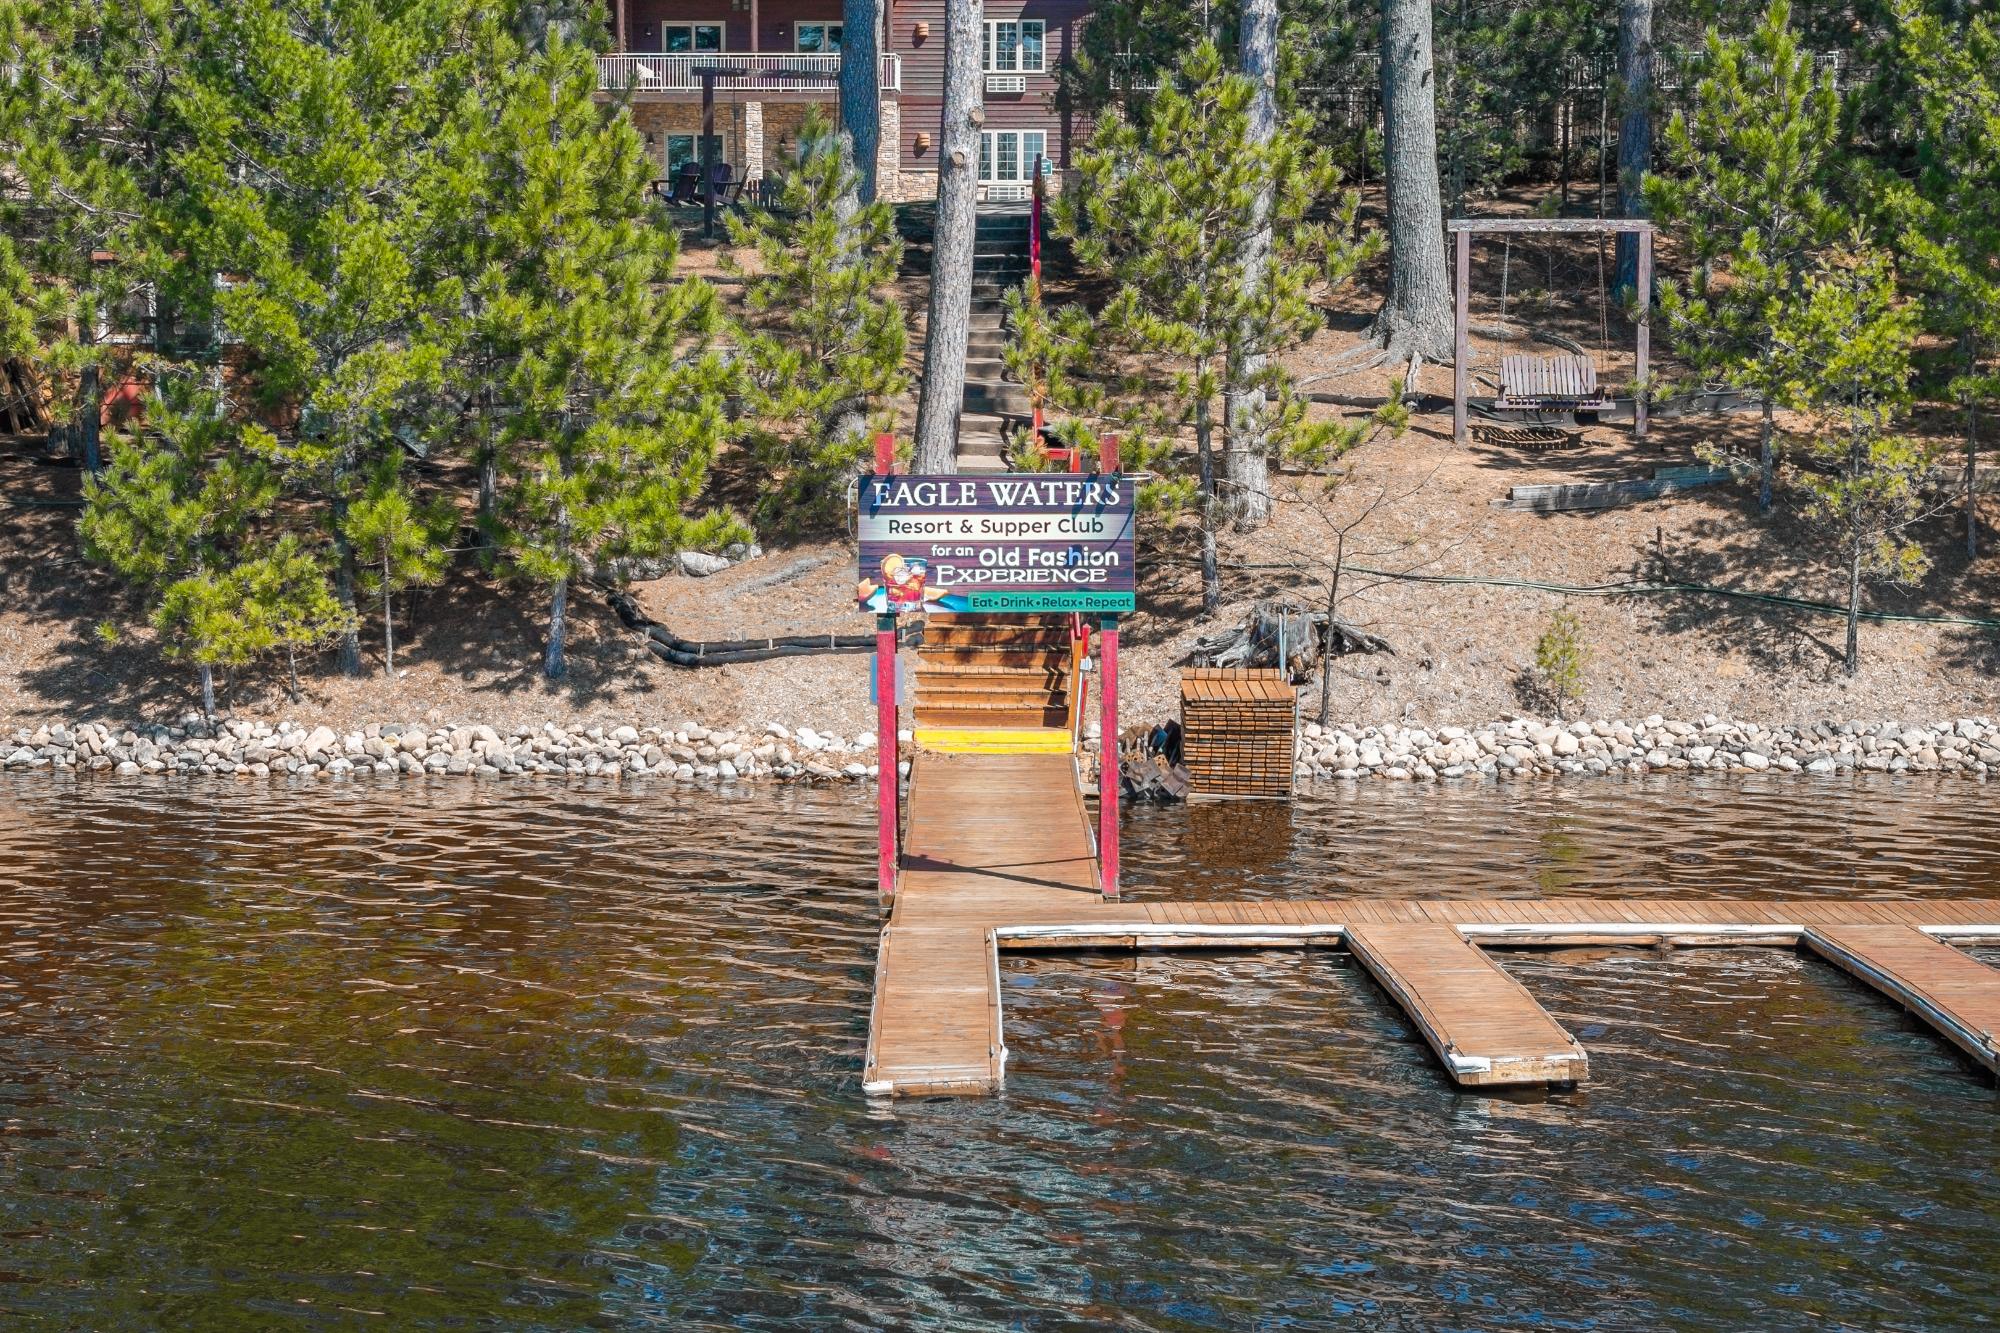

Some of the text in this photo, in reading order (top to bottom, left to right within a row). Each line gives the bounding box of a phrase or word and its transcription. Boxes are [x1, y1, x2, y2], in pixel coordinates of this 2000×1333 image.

[873, 482, 1120, 506] EAGLE WATERS
[889, 518, 1103, 536] Resort & Supper Club
[931, 544, 1118, 567] for an Old Fashion
[936, 565, 1107, 586] EXPERIENCE
[972, 596, 1131, 609] Eat Drink Relax Repeat
